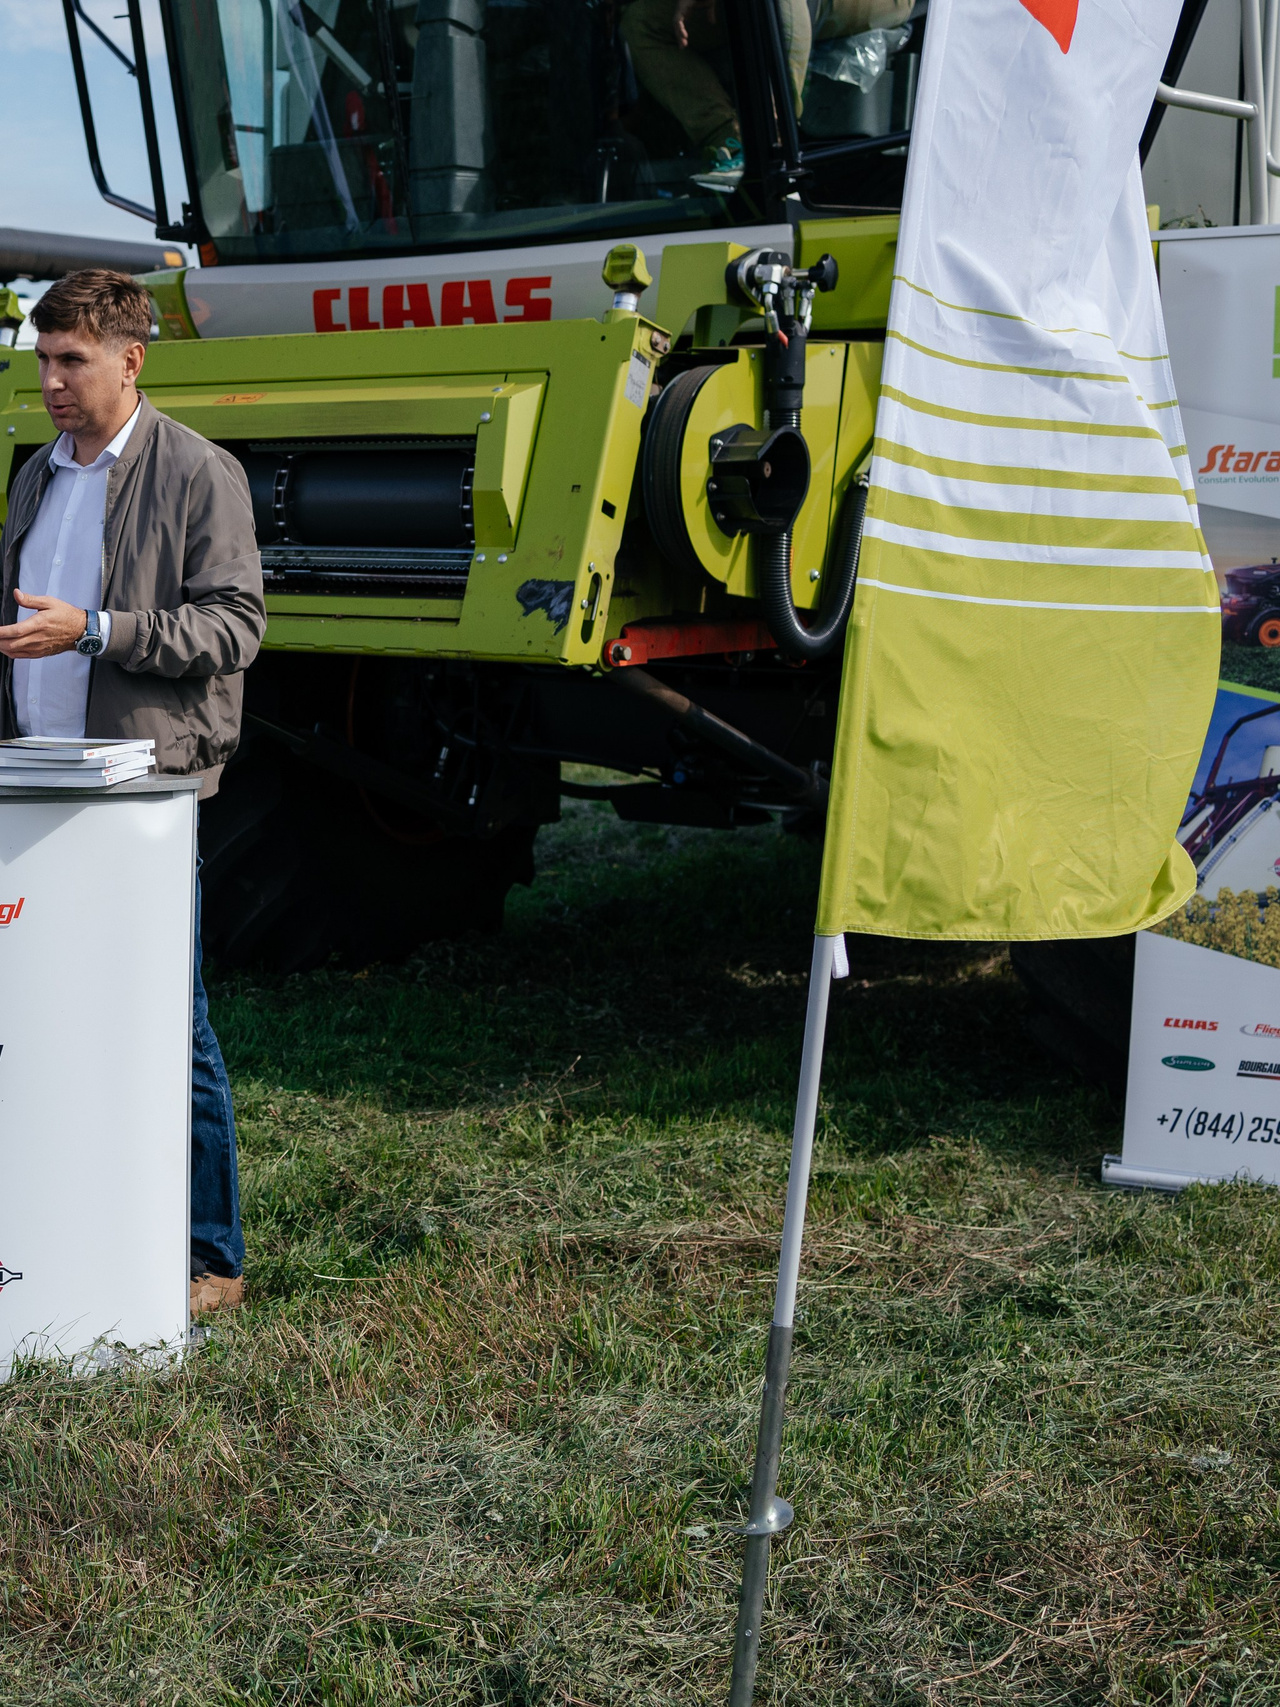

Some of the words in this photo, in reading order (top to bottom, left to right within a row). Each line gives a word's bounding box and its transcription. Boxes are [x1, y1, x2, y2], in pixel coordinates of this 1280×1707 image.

[313, 276, 552, 333] CLAAS
[1198, 444, 1280, 474] Stara
[1198, 475, 1237, 484] Constant
[1239, 474, 1280, 483] Evolution
[1163, 1017, 1219, 1032] CLAAS
